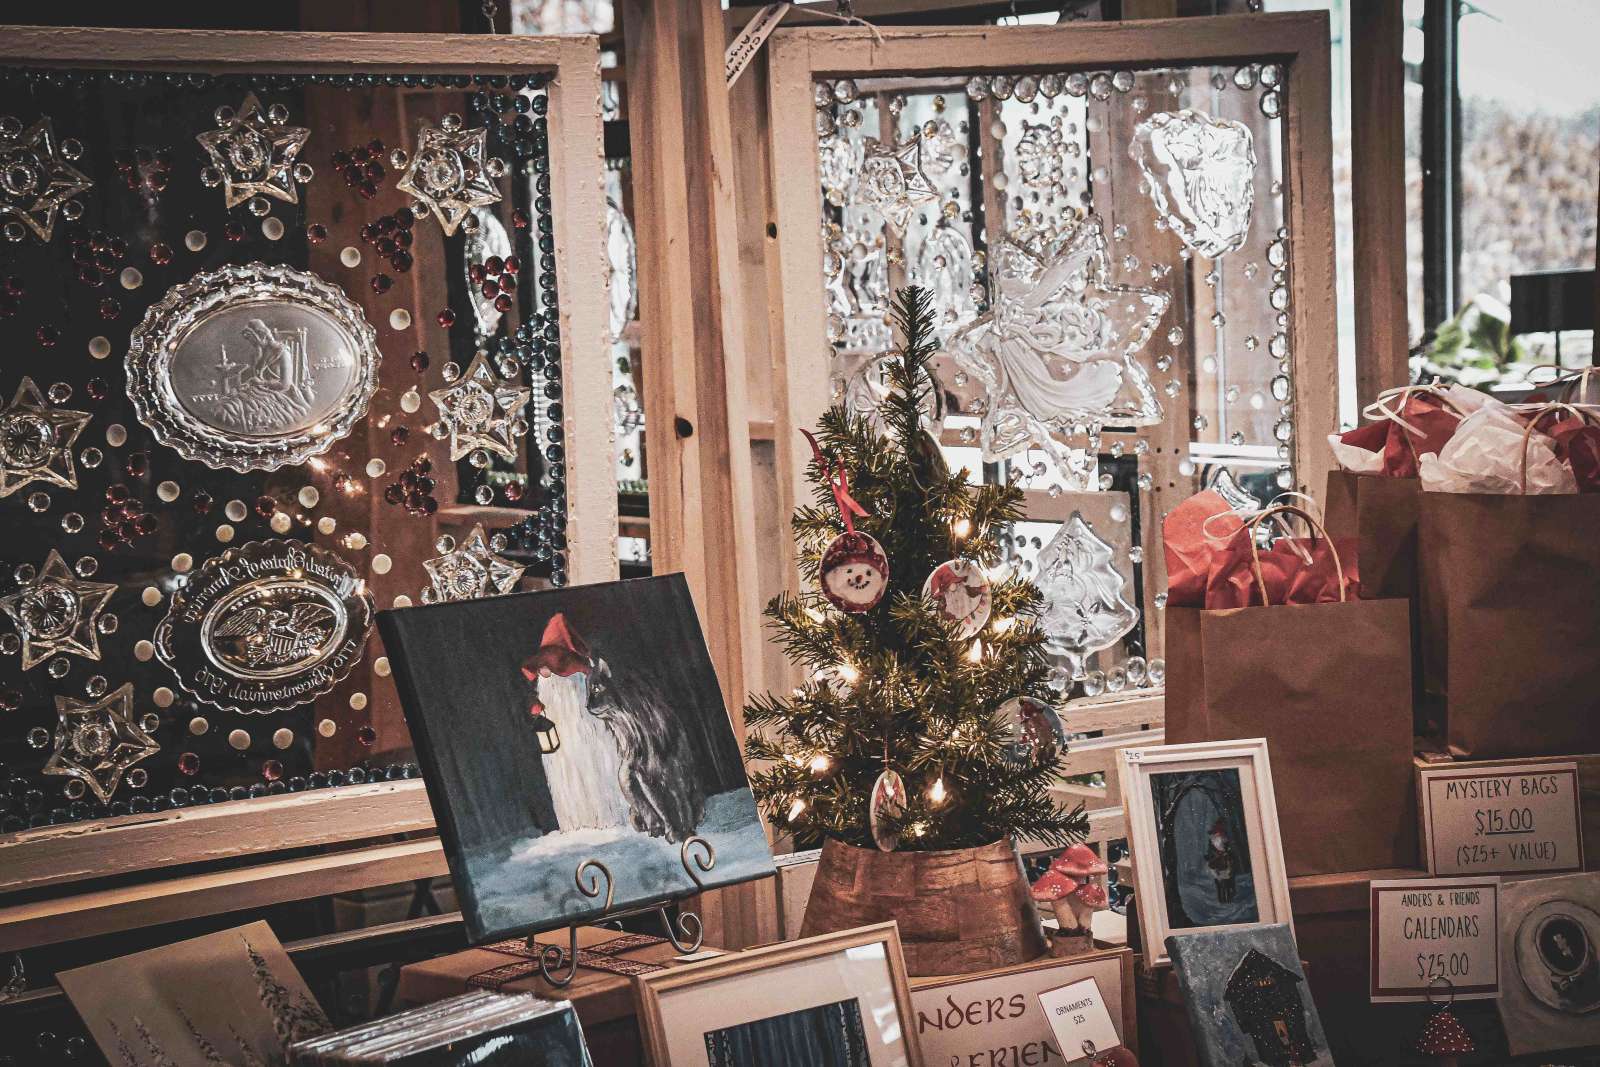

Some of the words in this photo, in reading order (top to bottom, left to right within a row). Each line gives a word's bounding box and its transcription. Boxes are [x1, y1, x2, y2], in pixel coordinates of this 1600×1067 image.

[1447, 779, 1512, 800] MYSTERY
[1521, 776, 1559, 796] BAGS
[1475, 807, 1535, 835] $15.00
[1457, 845, 1500, 867] ($25+
[1508, 841, 1557, 862] VALUE)
[1402, 893, 1433, 907] ANDERS
[1437, 894, 1445, 906] &
[1449, 891, 1480, 905] FRIENDS
[1404, 914, 1479, 940] CALENDARS
[1417, 952, 1469, 980] $25.00
[918, 993, 1026, 1034] NDERS
[1055, 997, 1093, 1017] ORNAMENTS
[1073, 1015, 1086, 1025] $25
[969, 1040, 1062, 1067] FRIEN
